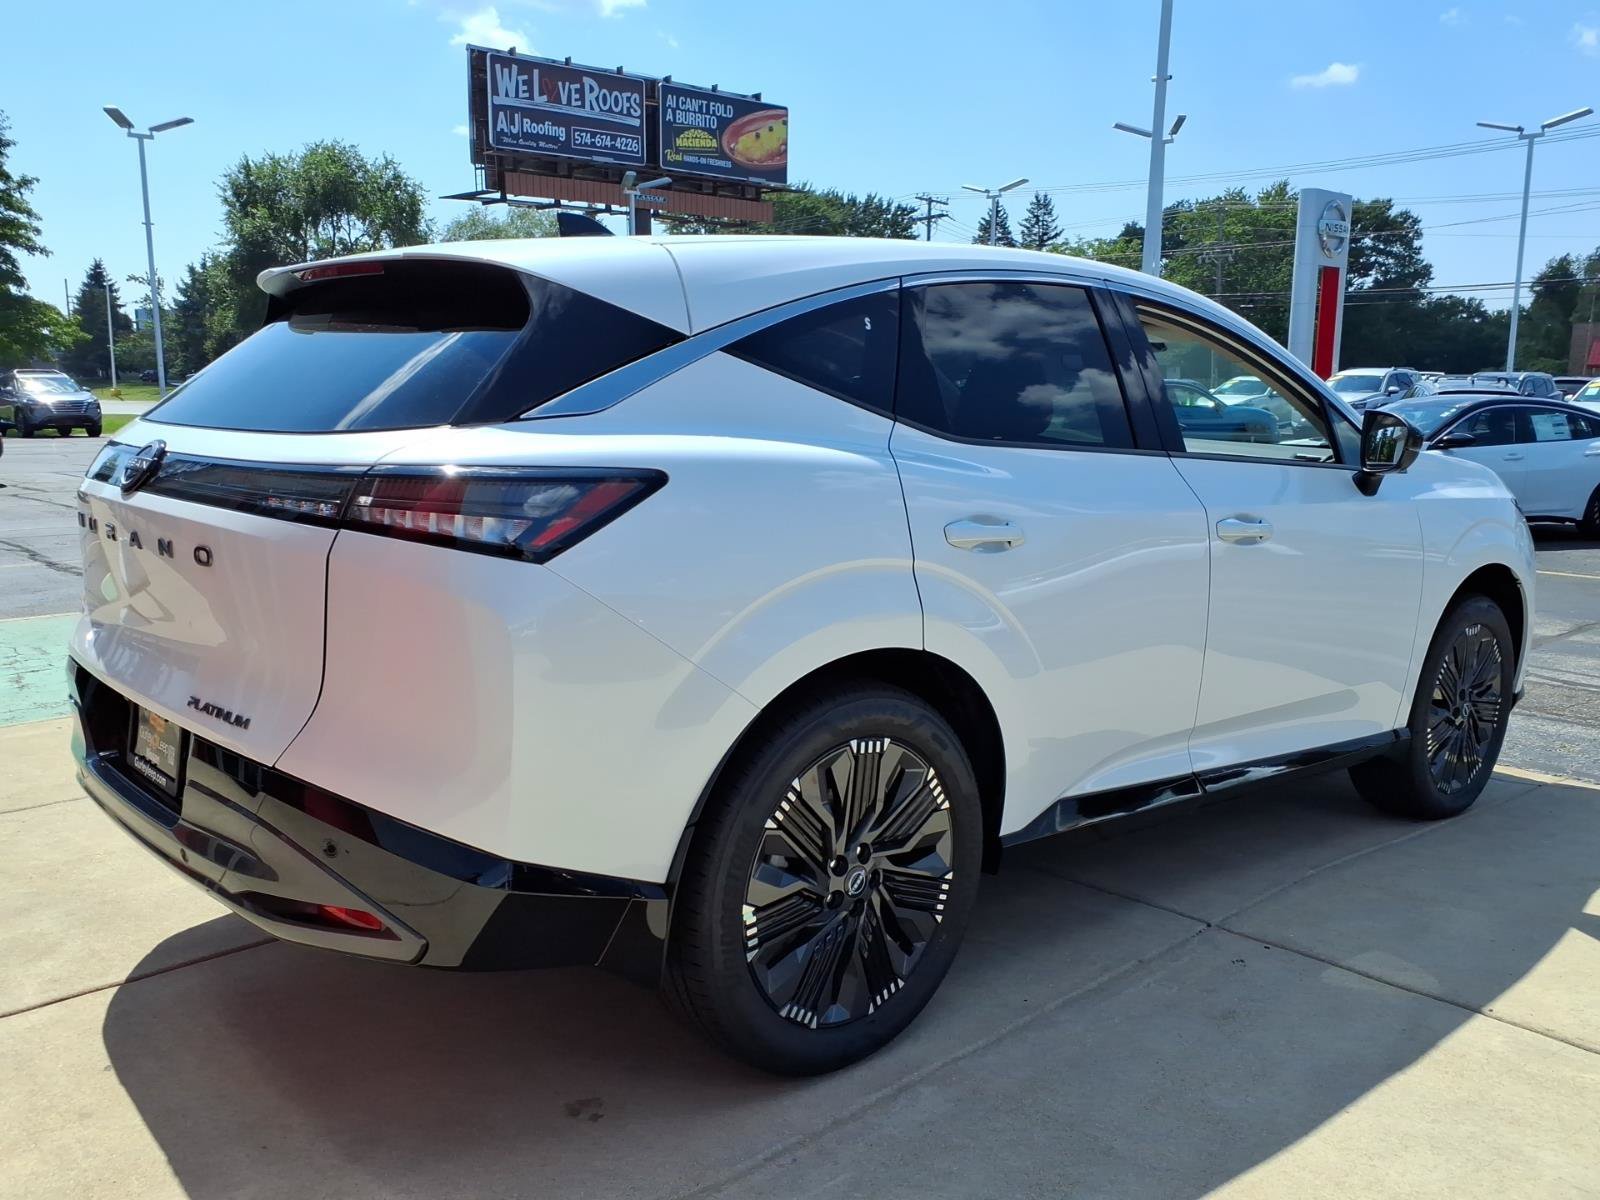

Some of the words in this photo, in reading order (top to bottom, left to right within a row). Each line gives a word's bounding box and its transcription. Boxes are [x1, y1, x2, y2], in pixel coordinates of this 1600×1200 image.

[495, 64, 529, 98] WE
[583, 76, 641, 117] ROOFS
[666, 94, 676, 108] AI
[678, 96, 707, 113] CAN'T
[709, 102, 734, 118] FOLD
[523, 118, 566, 141] Roofing
[666, 108, 673, 122] A
[675, 110, 718, 129] BURRITO
[574, 131, 639, 152] 574-674-4226
[675, 137, 718, 148] HACIENDA
[187, 695, 251, 730] PLATINUM
